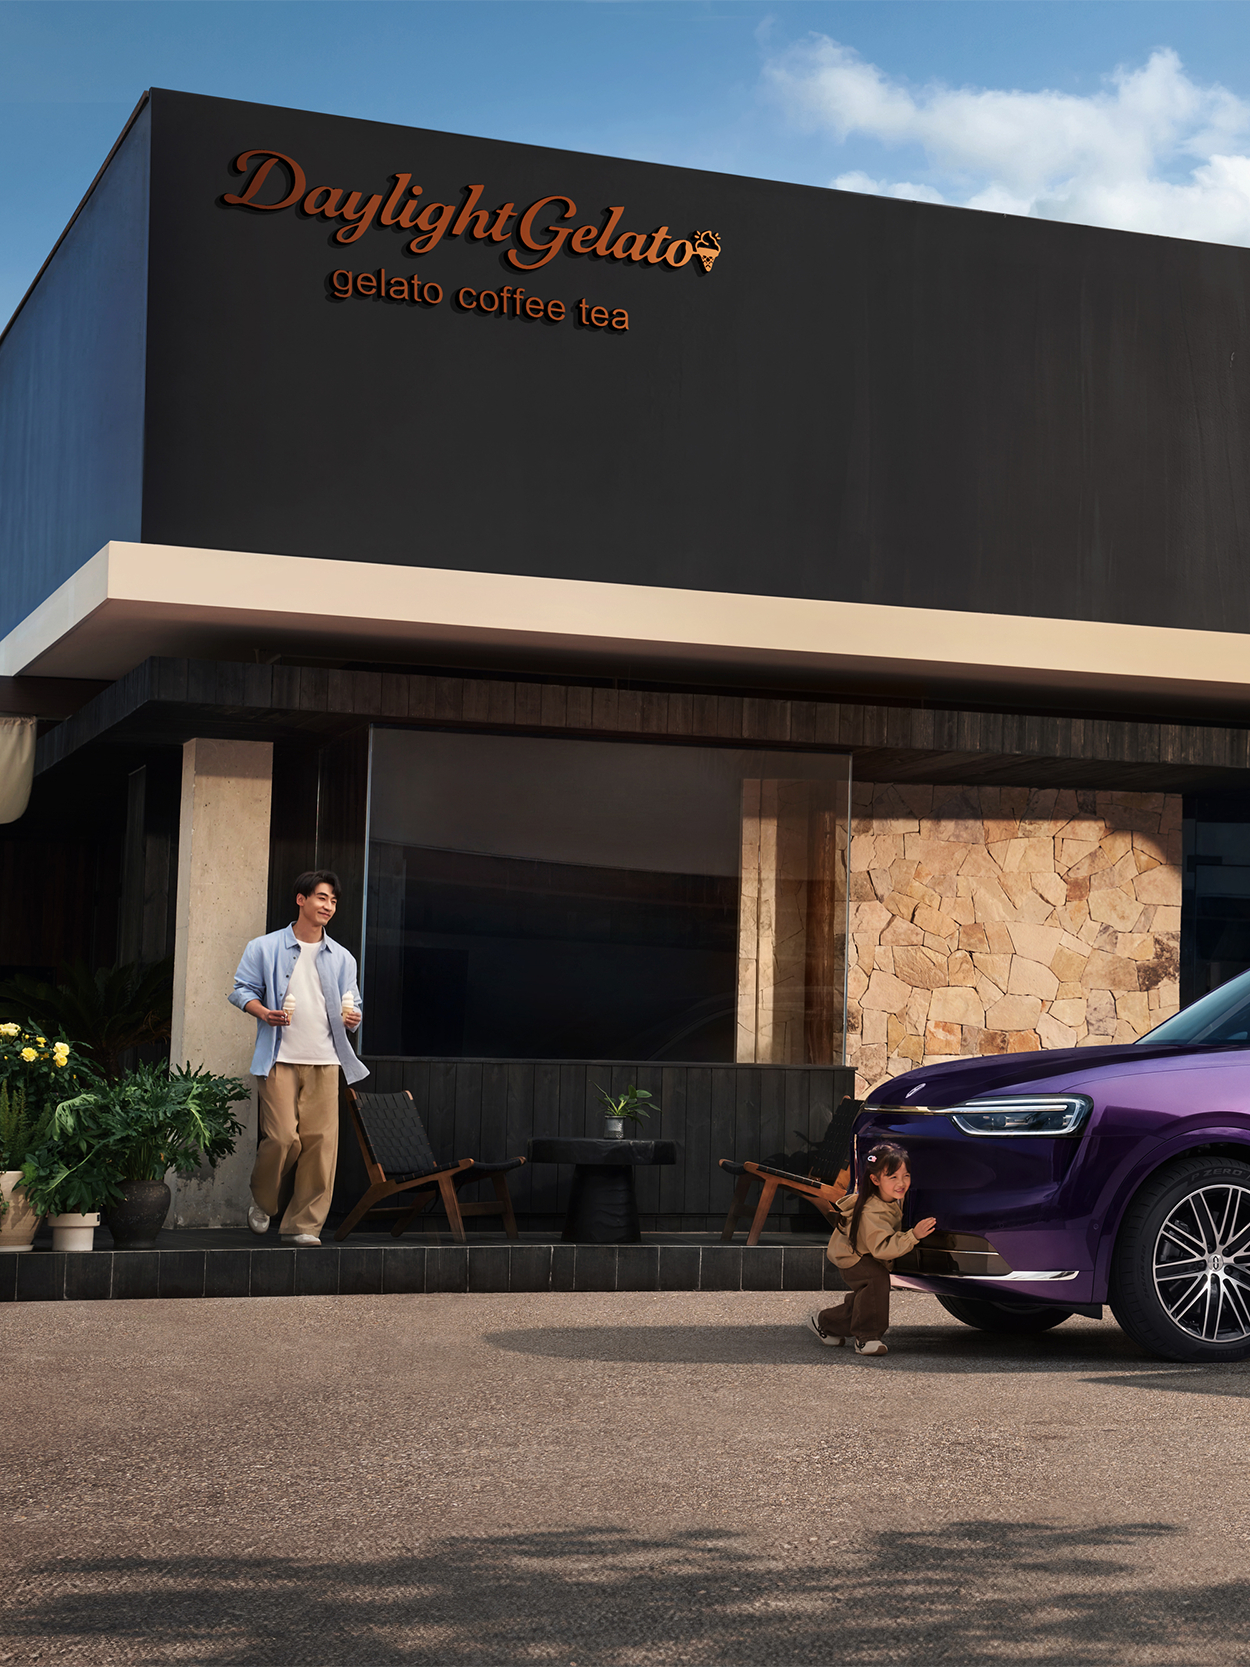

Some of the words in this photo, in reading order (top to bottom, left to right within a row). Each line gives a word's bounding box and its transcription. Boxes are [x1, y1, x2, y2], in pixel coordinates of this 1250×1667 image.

[332, 268, 444, 305] gelato
[458, 285, 566, 321] coffee
[579, 297, 631, 331] tea
[1202, 1168, 1243, 1178] ZERO
